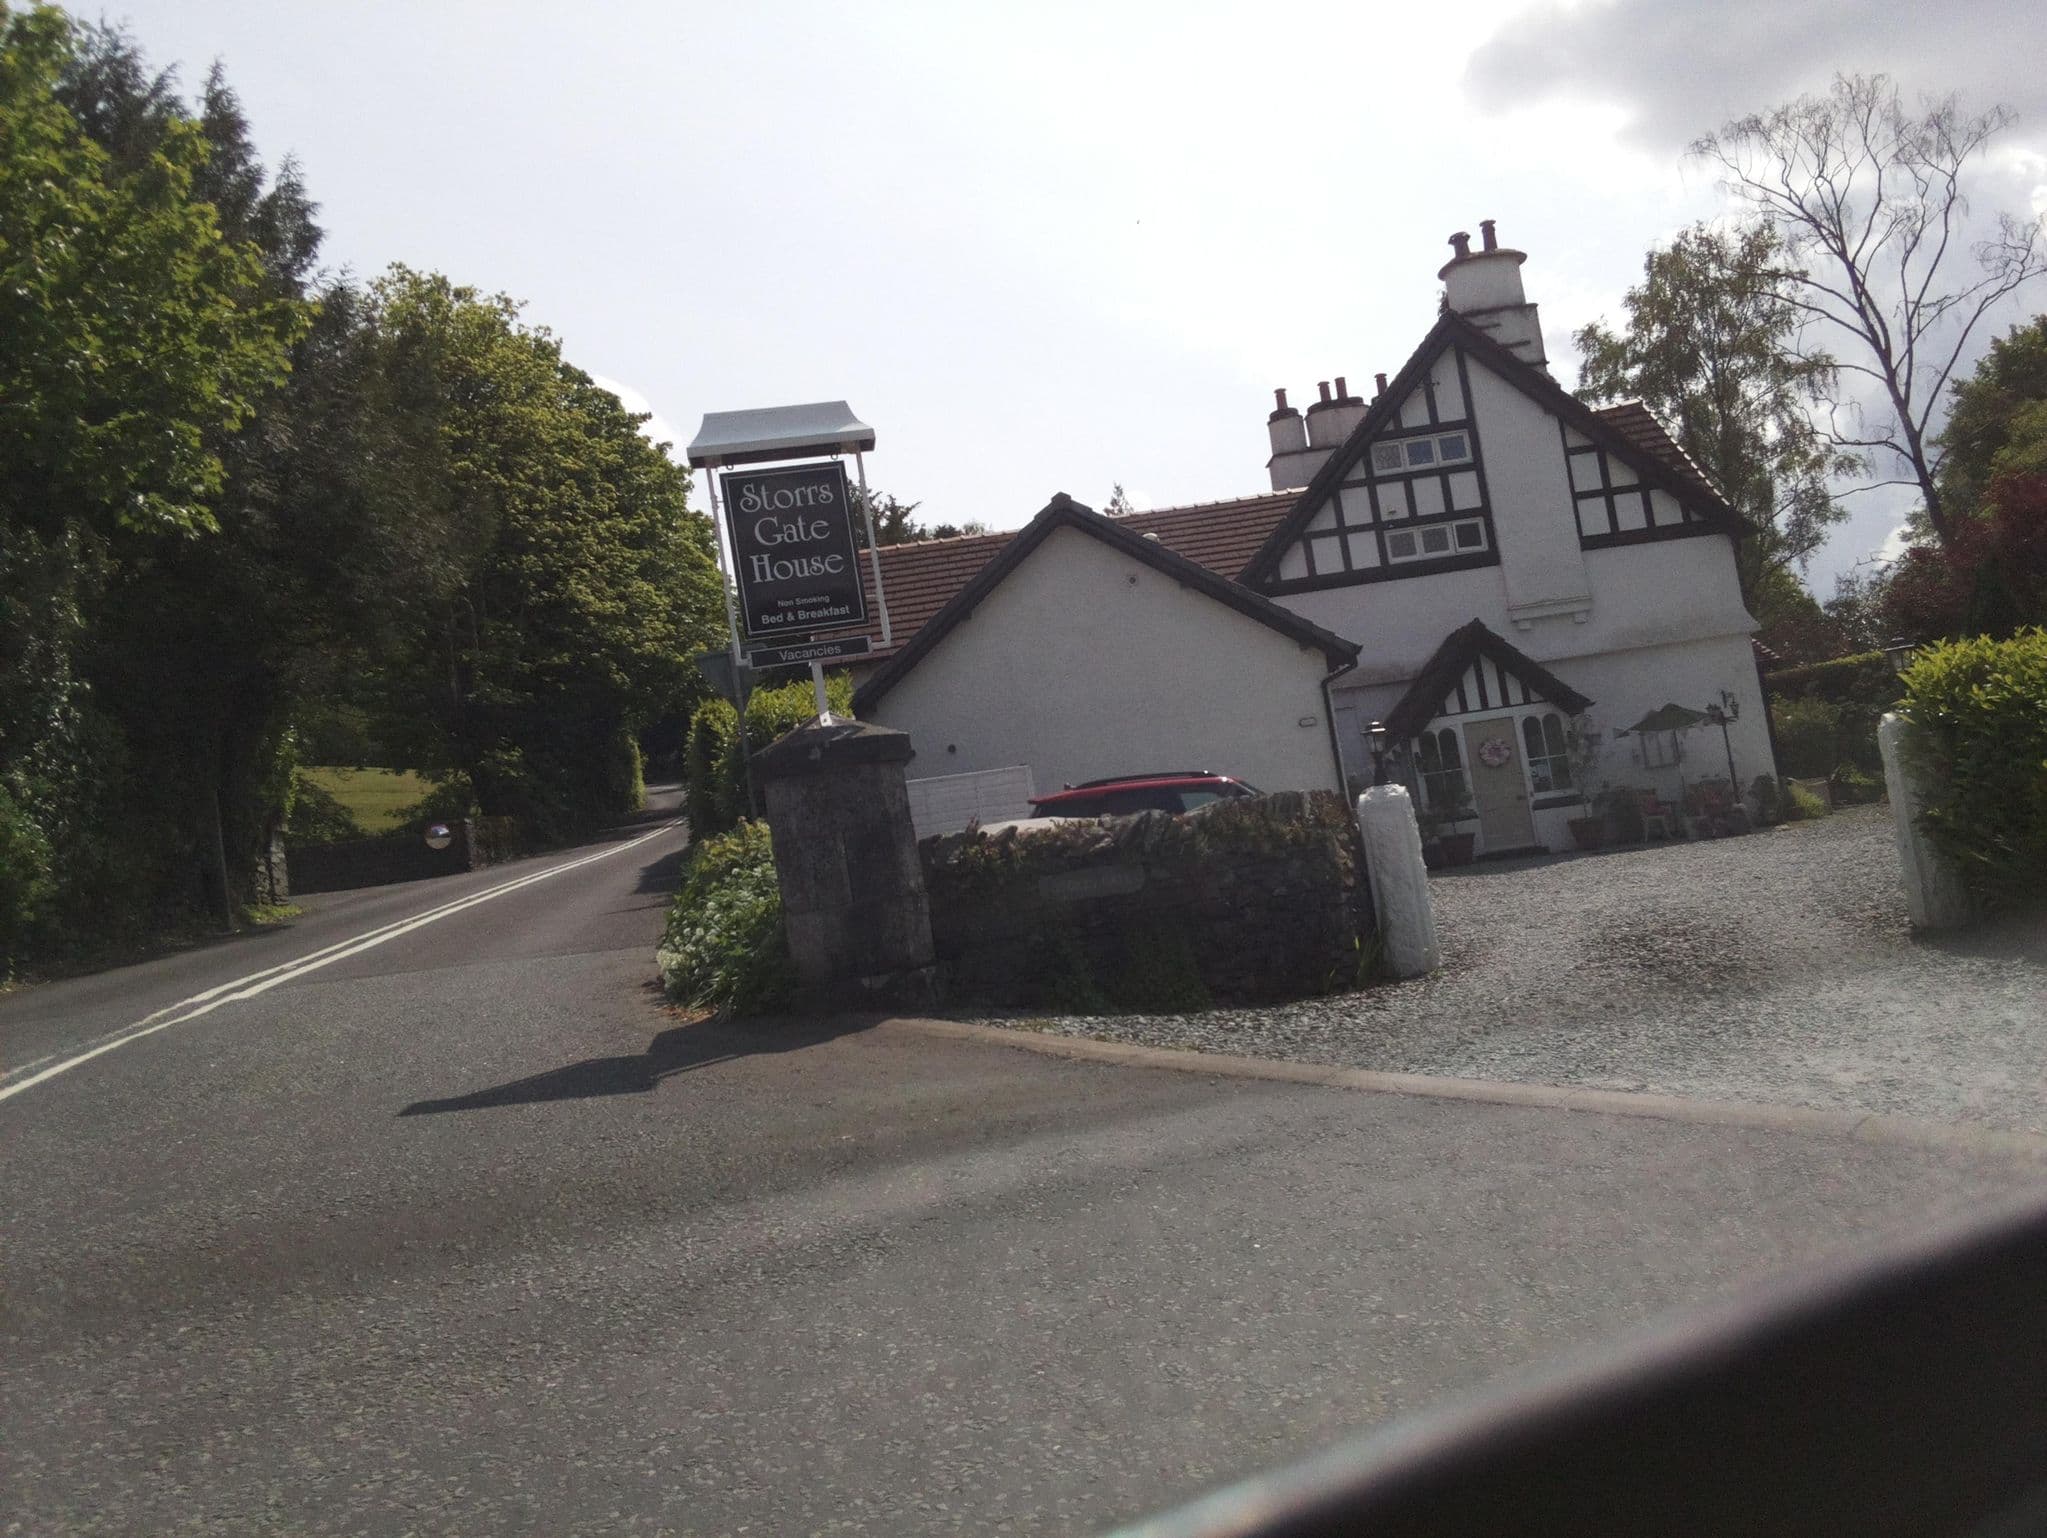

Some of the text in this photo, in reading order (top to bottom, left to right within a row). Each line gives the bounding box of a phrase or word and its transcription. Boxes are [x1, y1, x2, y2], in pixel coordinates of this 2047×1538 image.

[739, 483, 834, 513] Storrs
[754, 514, 831, 546] Gate
[750, 553, 845, 584] House
[777, 594, 830, 608] Non Smoking
[761, 605, 850, 625] Bed & Breakfast
[779, 645, 841, 662] Vacancies
